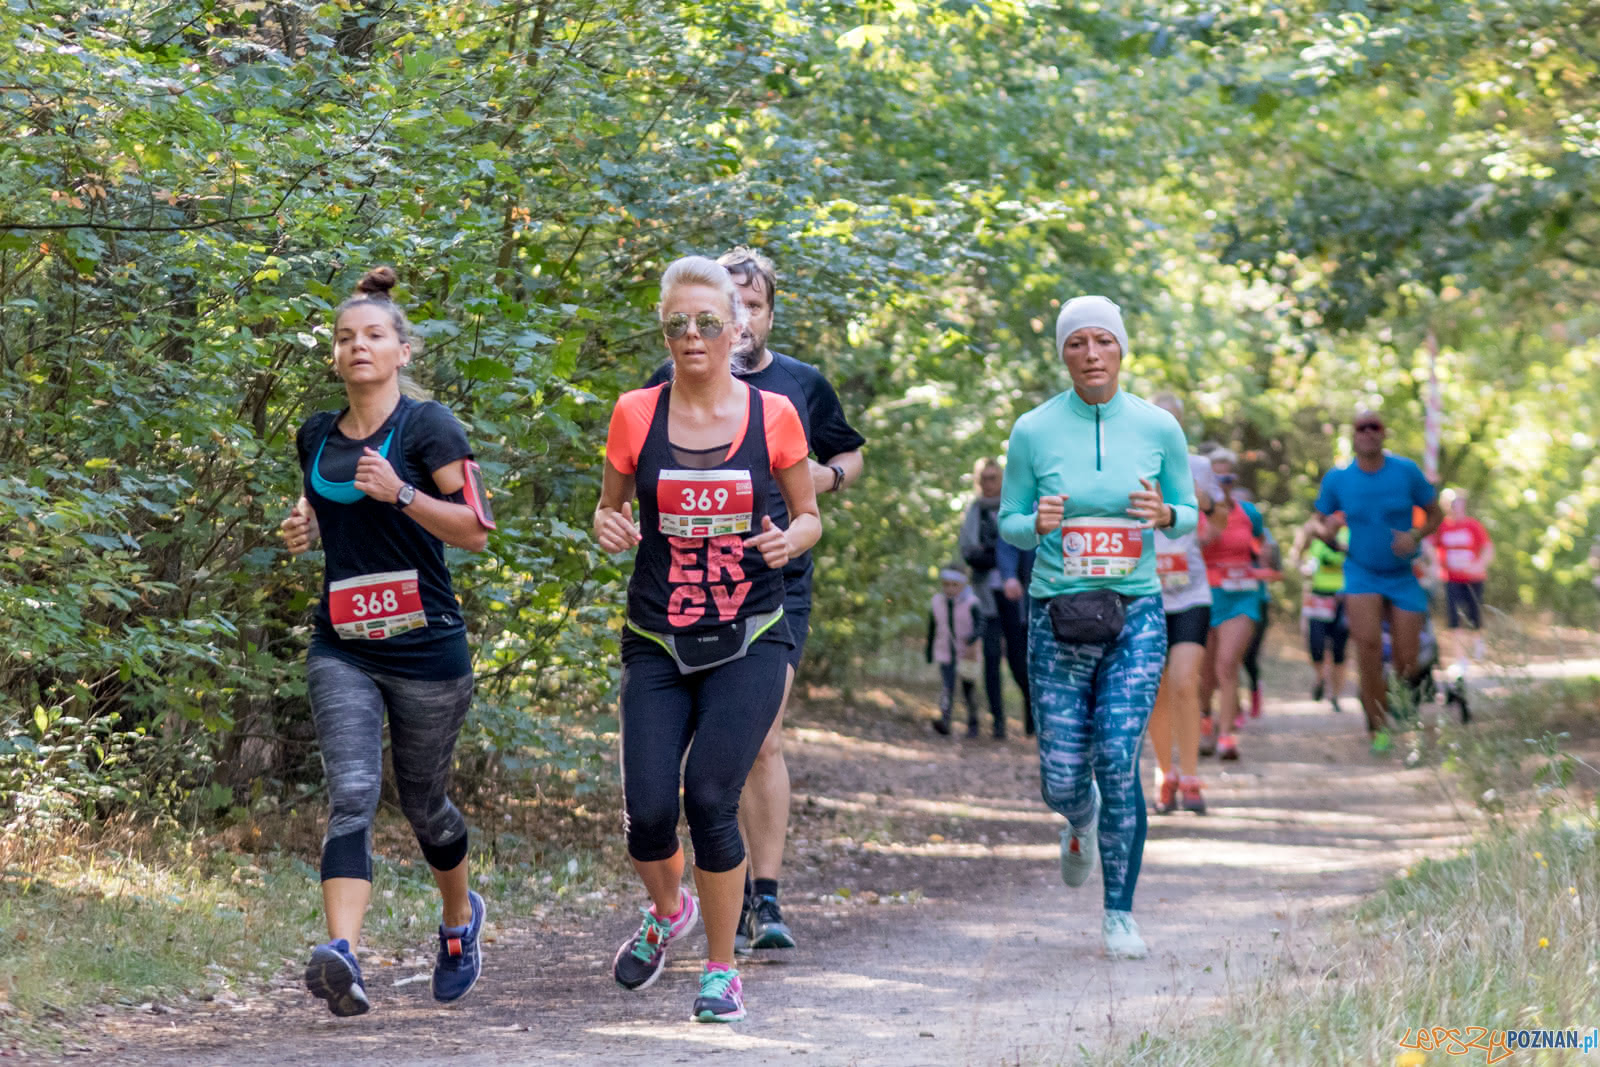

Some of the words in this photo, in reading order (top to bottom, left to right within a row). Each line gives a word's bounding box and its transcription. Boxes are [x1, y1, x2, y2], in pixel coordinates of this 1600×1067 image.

[681, 488, 728, 511] 369
[1083, 532, 1124, 553] 125
[668, 535, 745, 583] ER
[352, 589, 398, 617] 368
